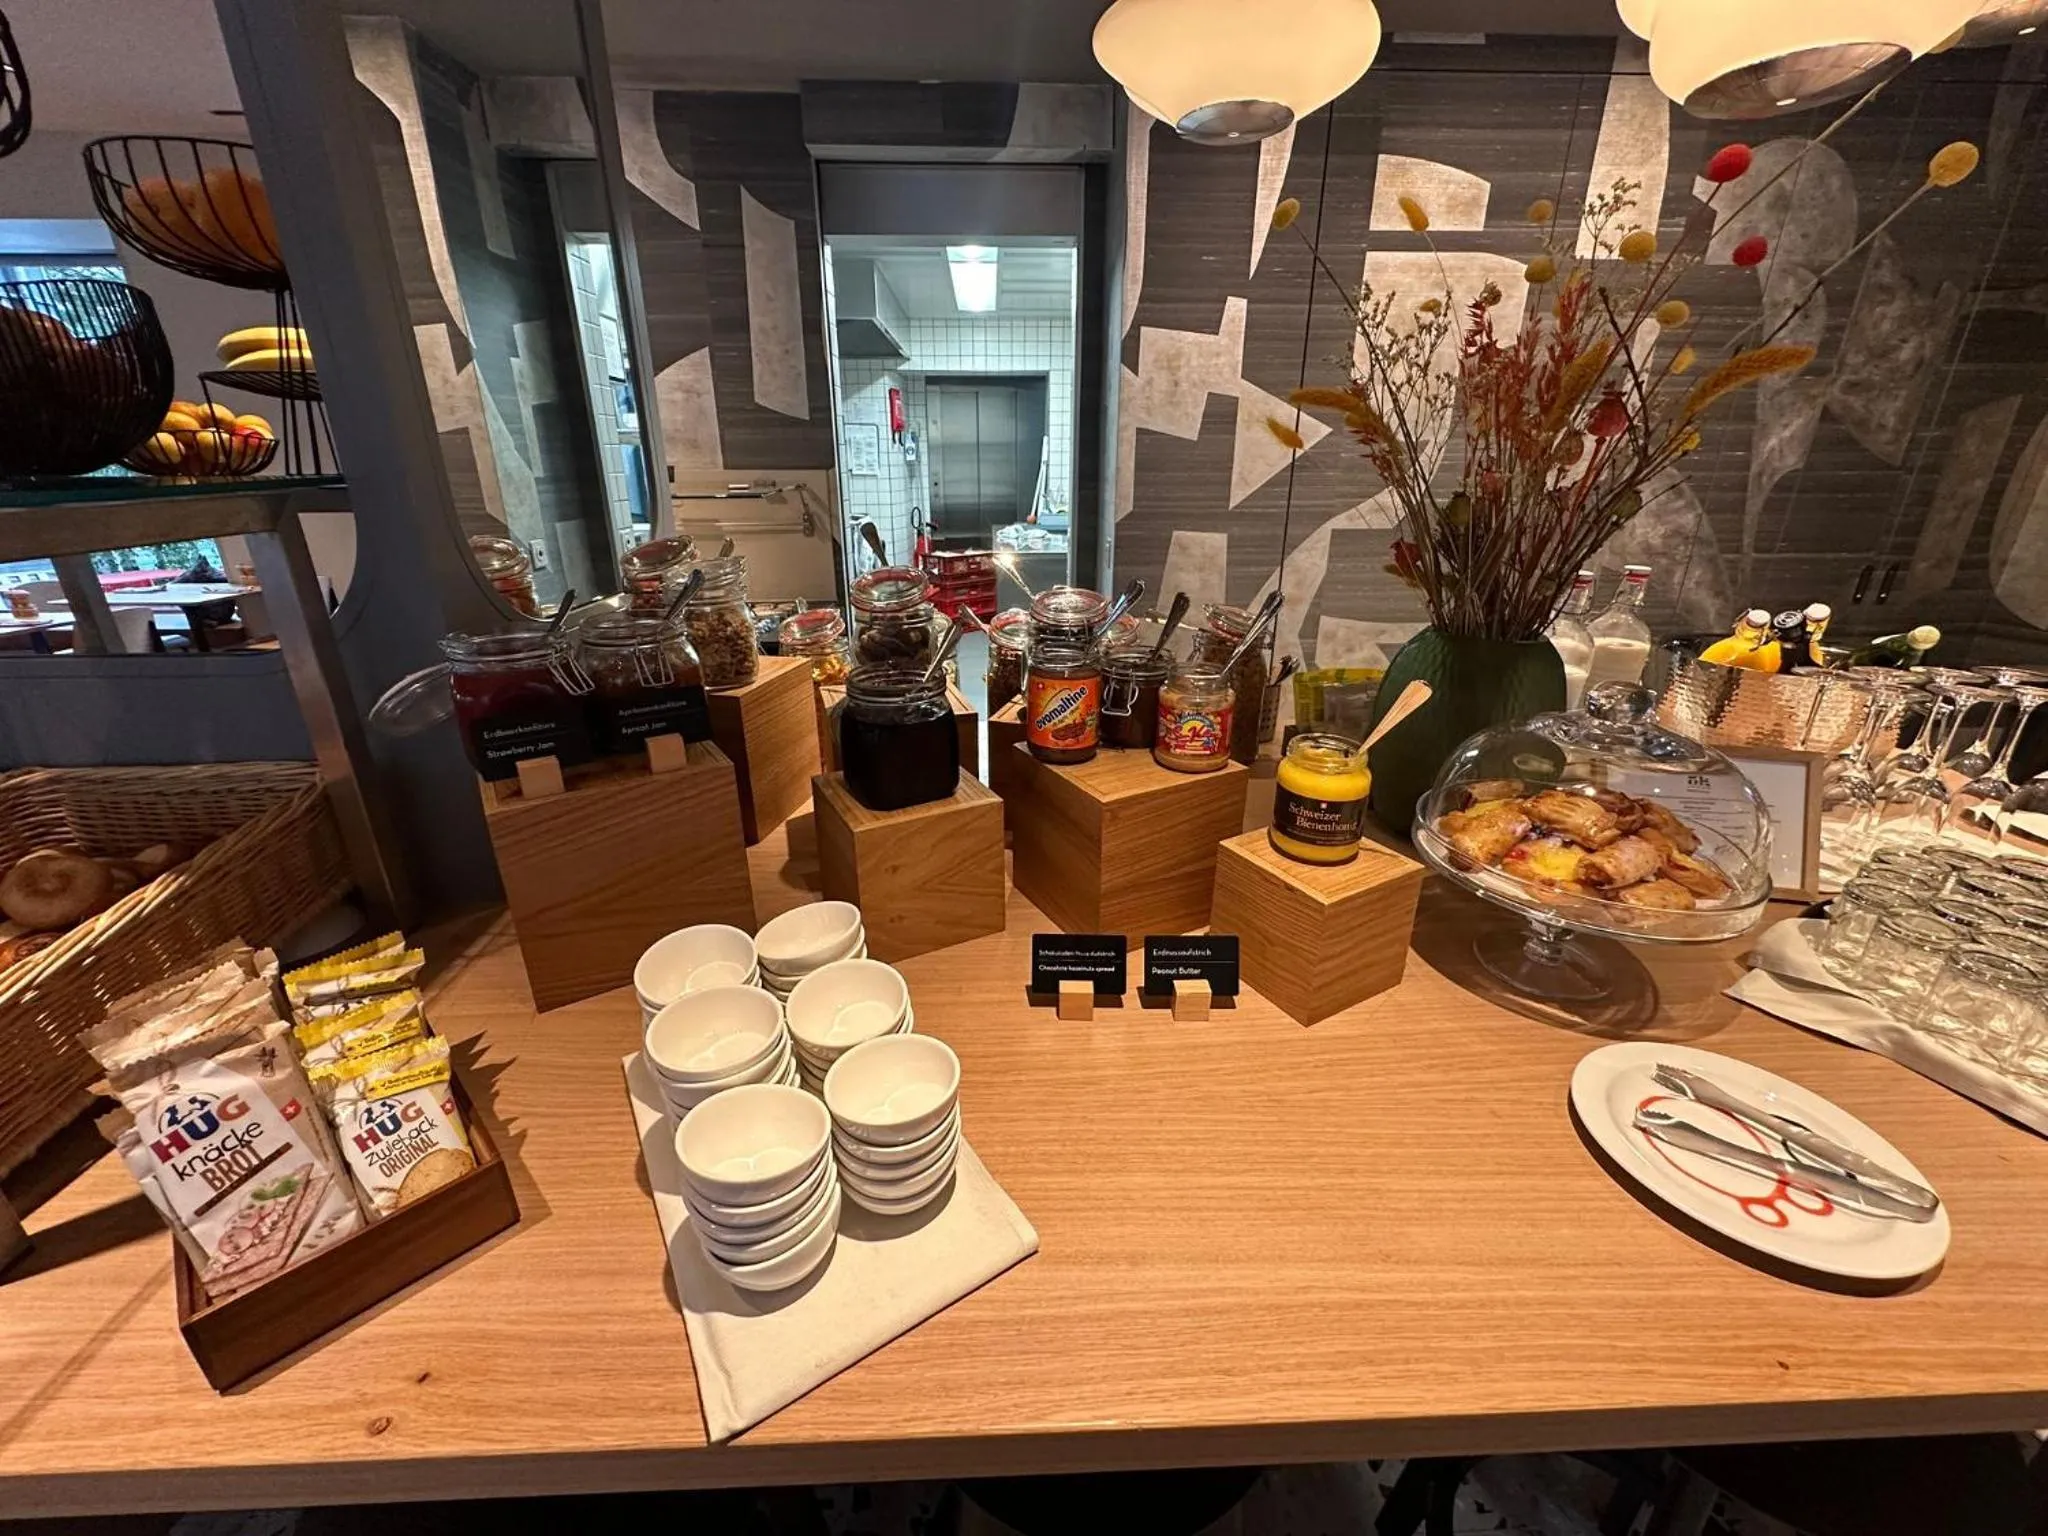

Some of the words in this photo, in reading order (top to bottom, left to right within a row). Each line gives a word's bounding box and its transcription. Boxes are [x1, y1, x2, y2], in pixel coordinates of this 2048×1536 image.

[1035, 686, 1088, 730] ovomaltine
[486, 744, 536, 760] Strawberry
[1288, 801, 1342, 821] Schweizer
[1095, 965, 1115, 973] spread
[1151, 966, 1178, 975] Peanut
[1178, 966, 1202, 975] Butter
[149, 1094, 251, 1164] HUG
[352, 1101, 425, 1153] HUG
[365, 1115, 439, 1167] zwieback
[171, 1122, 264, 1182] knäcke
[200, 1140, 264, 1192] BROT
[379, 1134, 440, 1178] ORIGINAL
